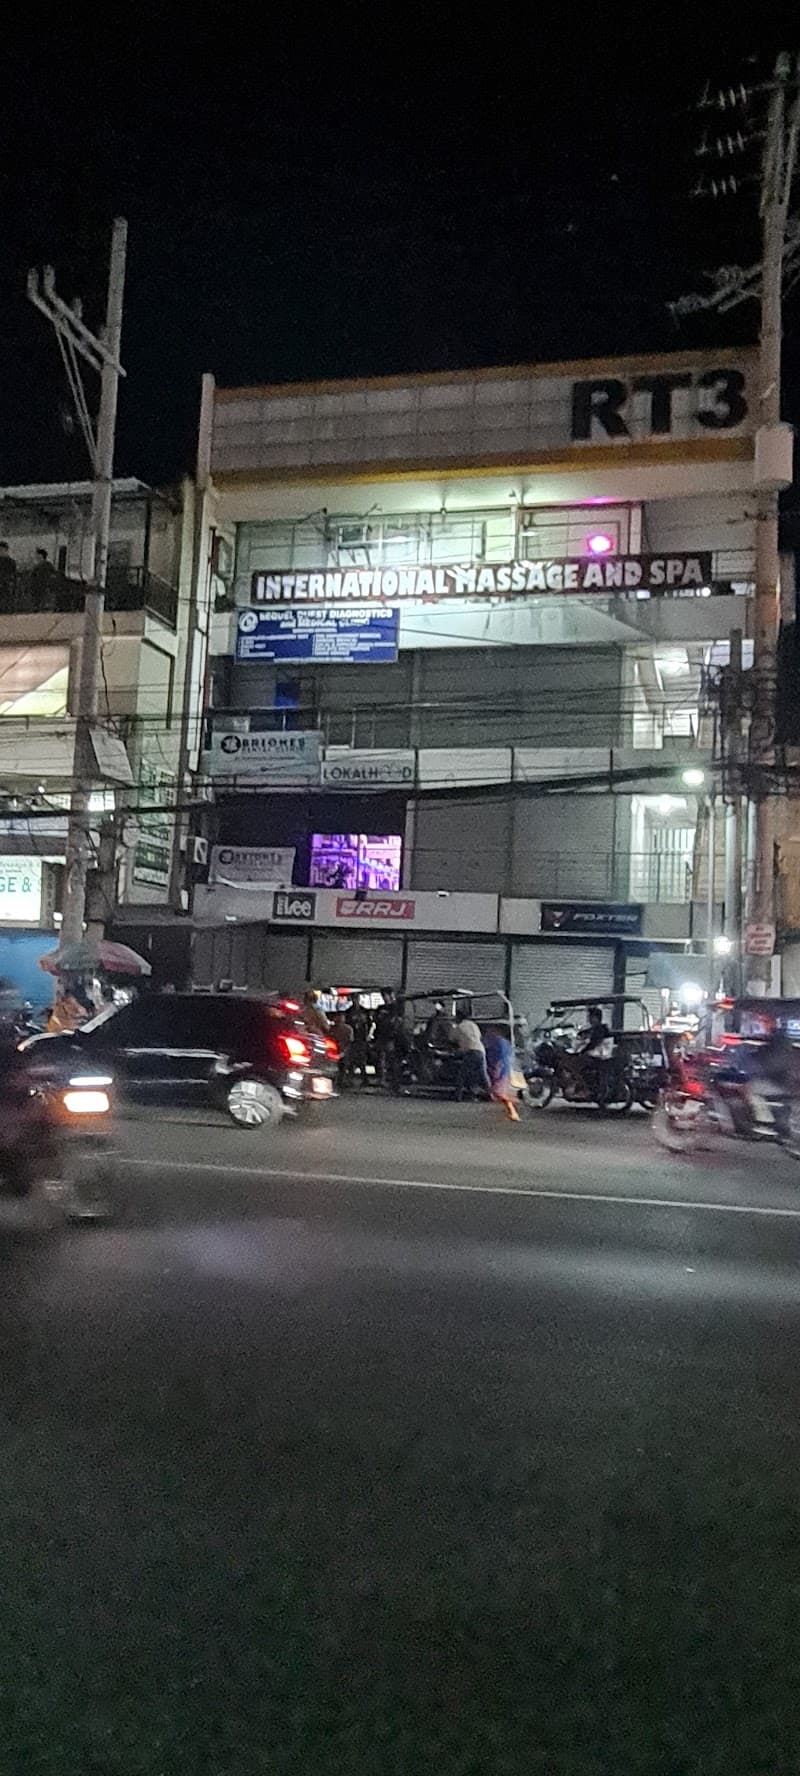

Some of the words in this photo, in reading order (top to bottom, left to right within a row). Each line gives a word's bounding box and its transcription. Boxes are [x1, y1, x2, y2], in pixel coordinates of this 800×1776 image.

[572, 369, 748, 440] RT3
[256, 569, 449, 600] INTERNATIONAL
[454, 563, 579, 593] MASSAGE
[583, 561, 643, 588] AND
[649, 558, 703, 585] SPA
[259, 610, 294, 621] SEQUEL
[329, 608, 393, 619] DIAGNOSTICS
[297, 618, 338, 628] MEDICAL
[242, 736, 306, 748] BRIONES
[22, 876, 33, 893] &
[285, 895, 312, 917] Lee
[355, 900, 407, 916] RRJ
